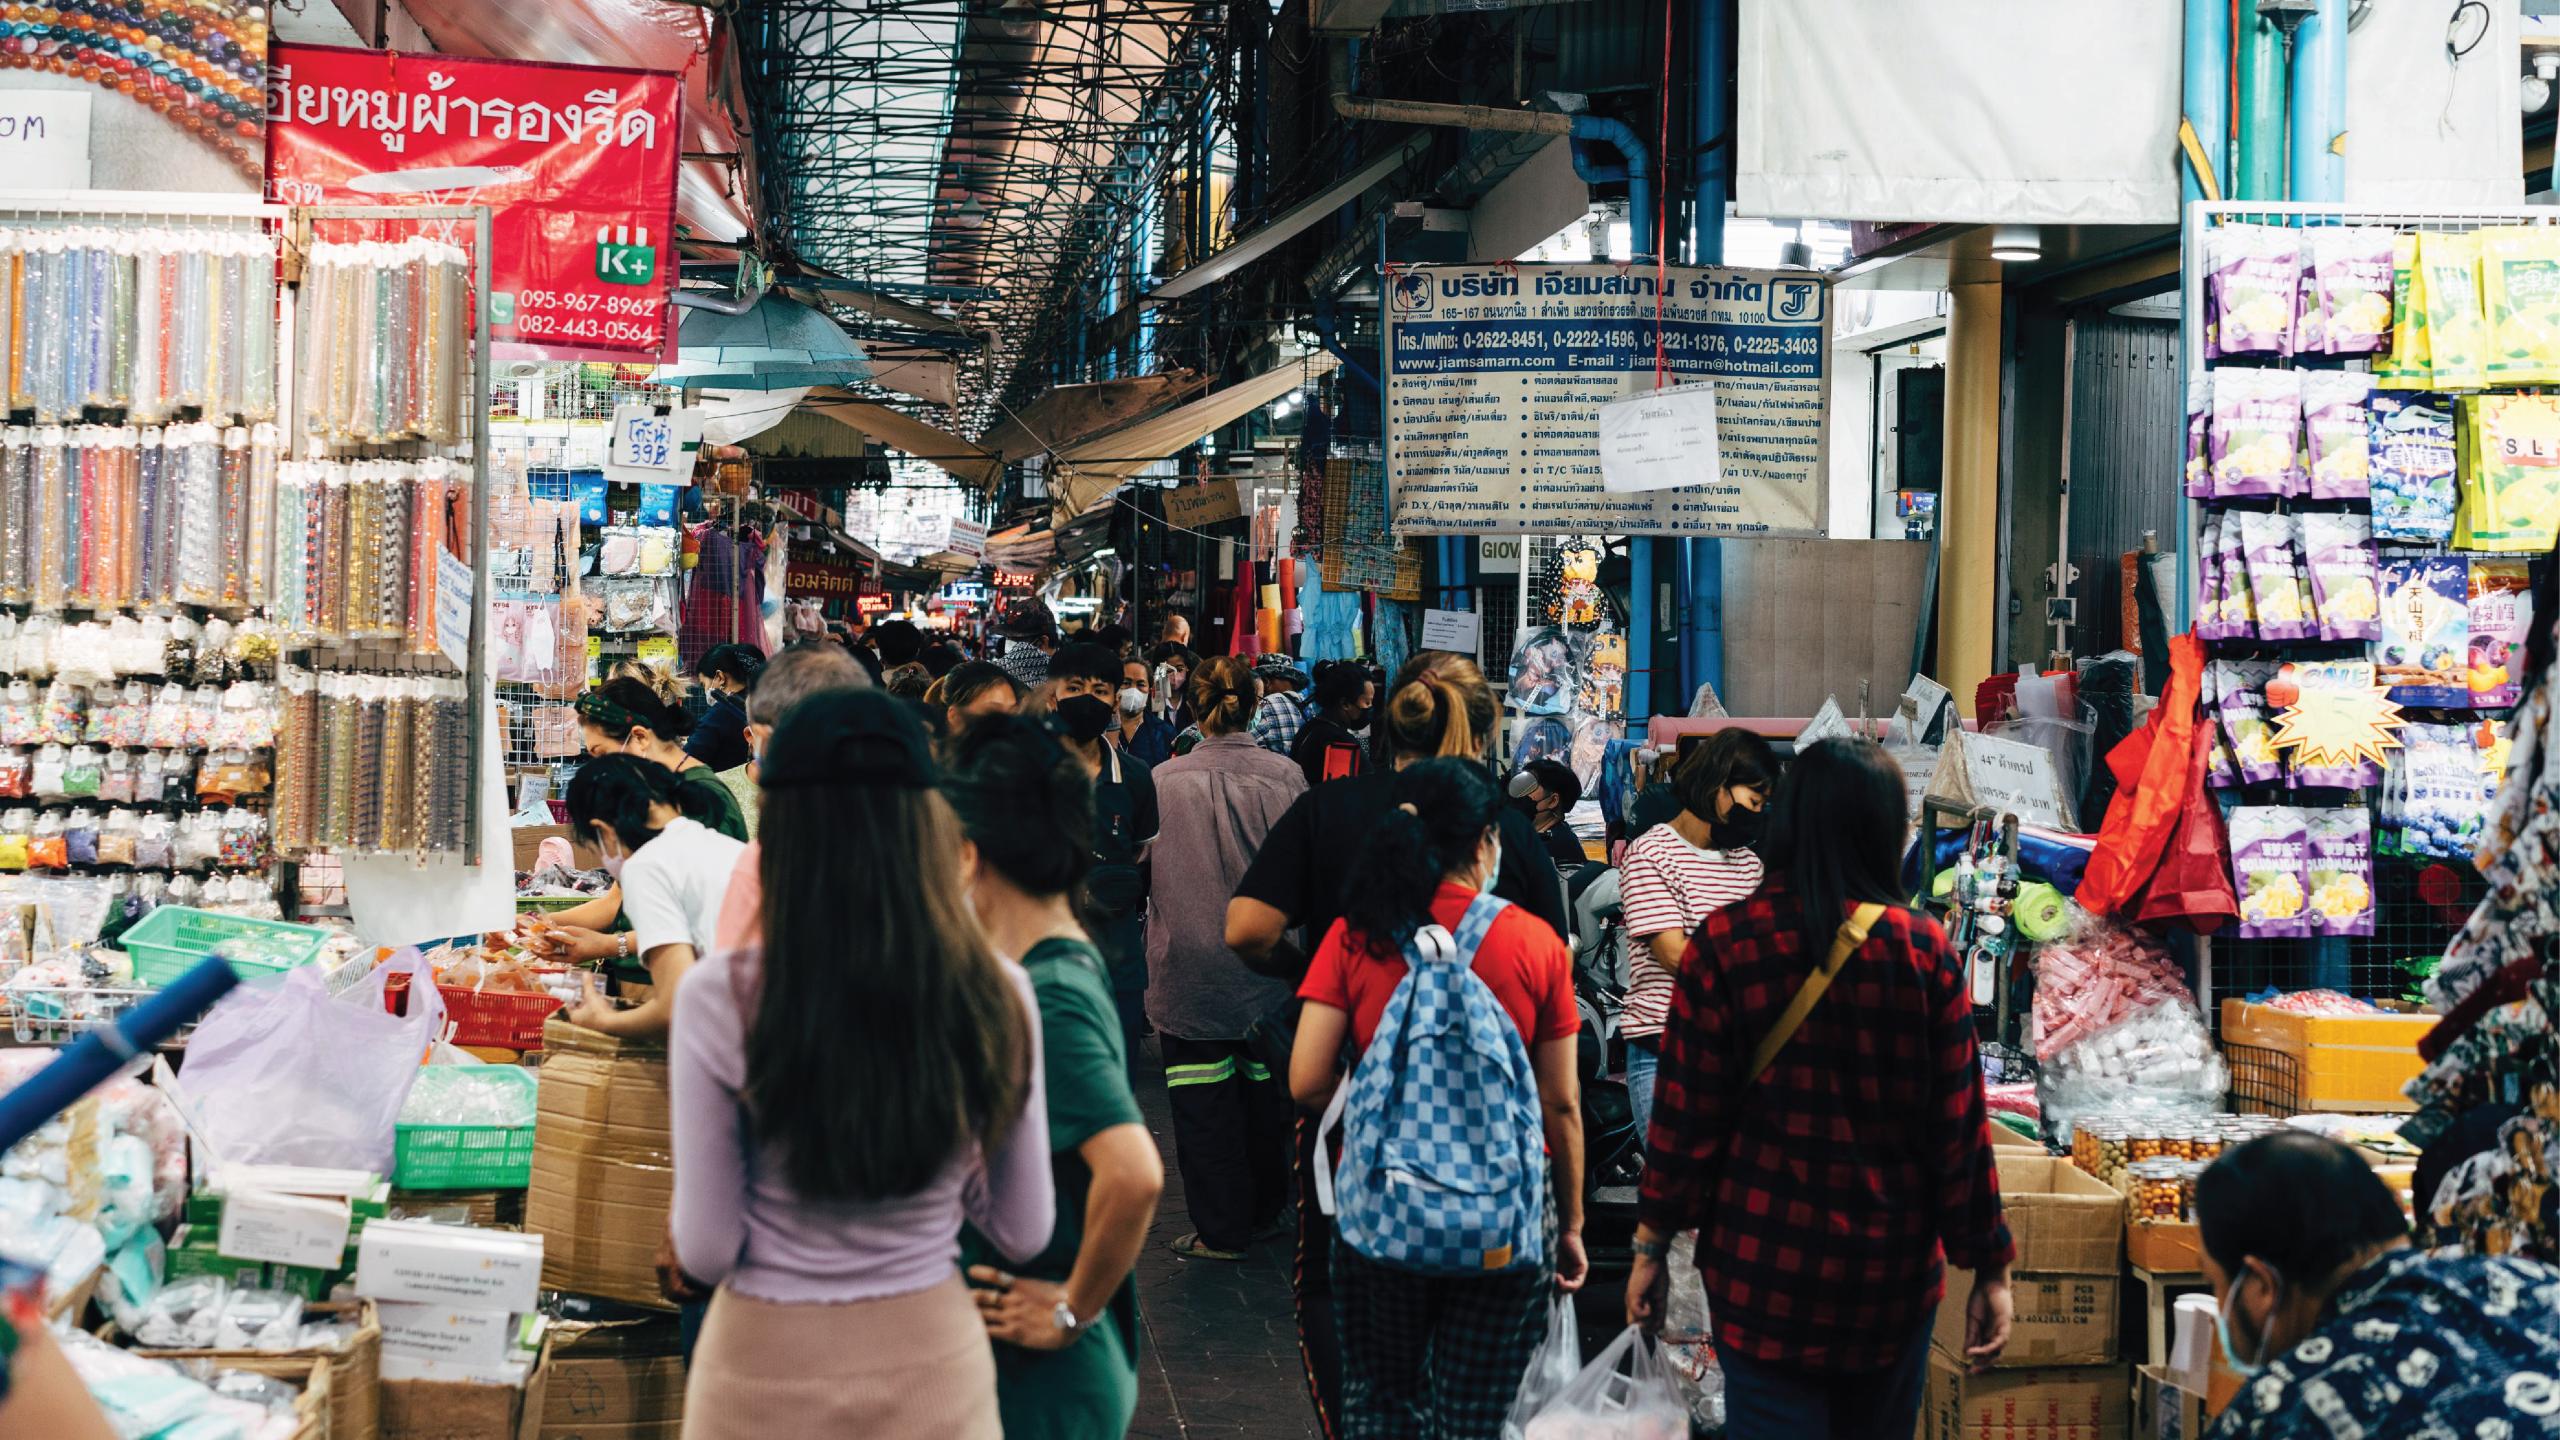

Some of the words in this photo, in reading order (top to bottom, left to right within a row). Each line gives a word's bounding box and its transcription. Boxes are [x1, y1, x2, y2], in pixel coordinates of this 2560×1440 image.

[601, 247, 648, 276] K+
[1441, 270, 1519, 297] บริษัท
[1536, 270, 1675, 297] เจียมสมาน
[1690, 274, 1763, 302] จำกัด
[520, 289, 656, 318] 095-967-8962
[1440, 307, 1480, 320] 165-167
[1738, 311, 1766, 324] 10100
[519, 314, 654, 342] 082-443-0564
[1733, 336, 1818, 356] 0-2225-3403
[1399, 354, 1556, 372] www.jiamsamarn.com
[1568, 354, 1614, 367] E-mail
[1481, 541, 1542, 560] GIOVN
[526, 604, 539, 612] KF9
[2306, 857, 2368, 873] OLUOMIGAN
